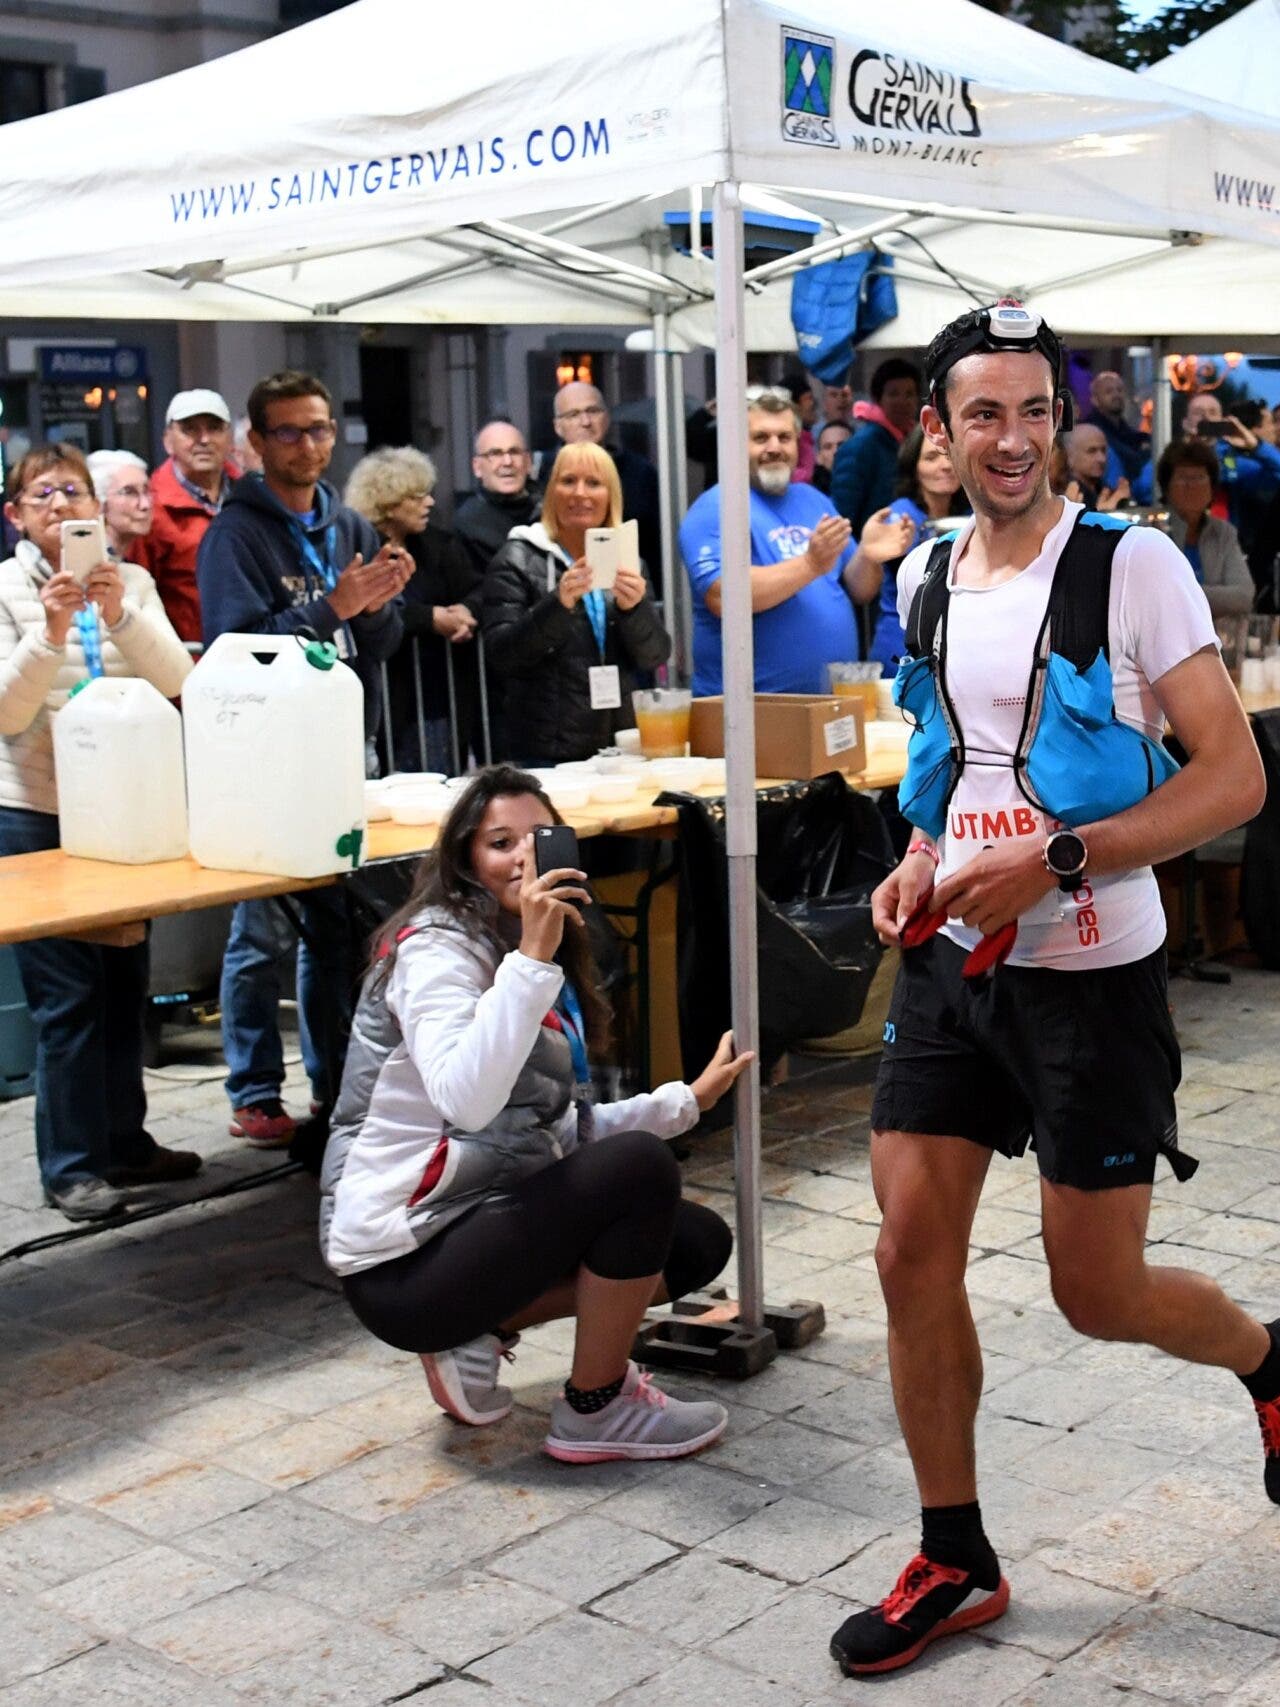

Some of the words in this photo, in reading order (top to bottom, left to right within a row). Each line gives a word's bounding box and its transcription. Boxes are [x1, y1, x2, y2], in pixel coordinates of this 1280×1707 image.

[848, 49, 981, 137] GERVAIS
[170, 118, 611, 223] WWW.SAINTGERVAIS.COM
[853, 135, 983, 167] MONT-BLANC
[951, 808, 1037, 840] UTMB
